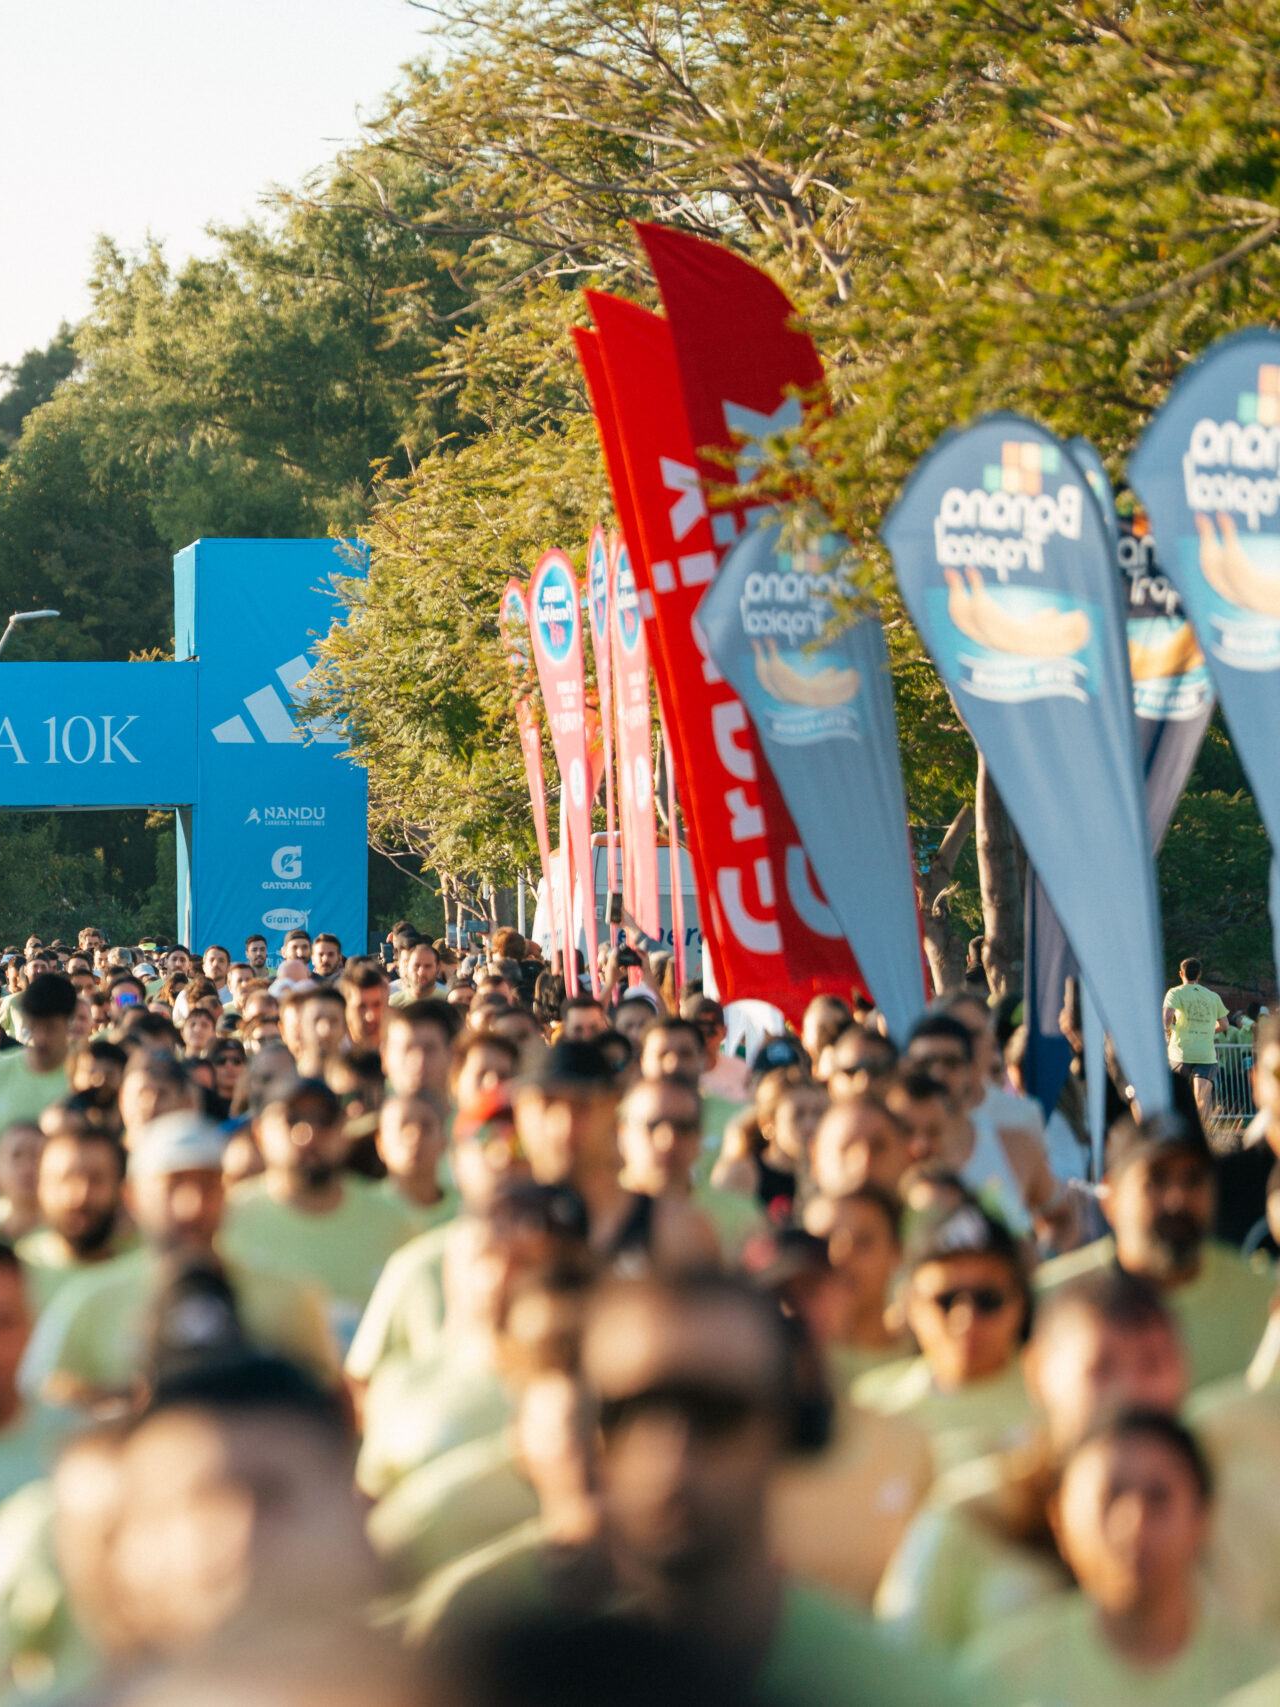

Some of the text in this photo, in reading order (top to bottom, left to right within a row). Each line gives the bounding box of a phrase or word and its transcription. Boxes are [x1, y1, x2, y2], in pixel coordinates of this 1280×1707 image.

[42, 715, 141, 764] 10K
[261, 882, 312, 890] GATORADE
[265, 915, 299, 925] Granix
